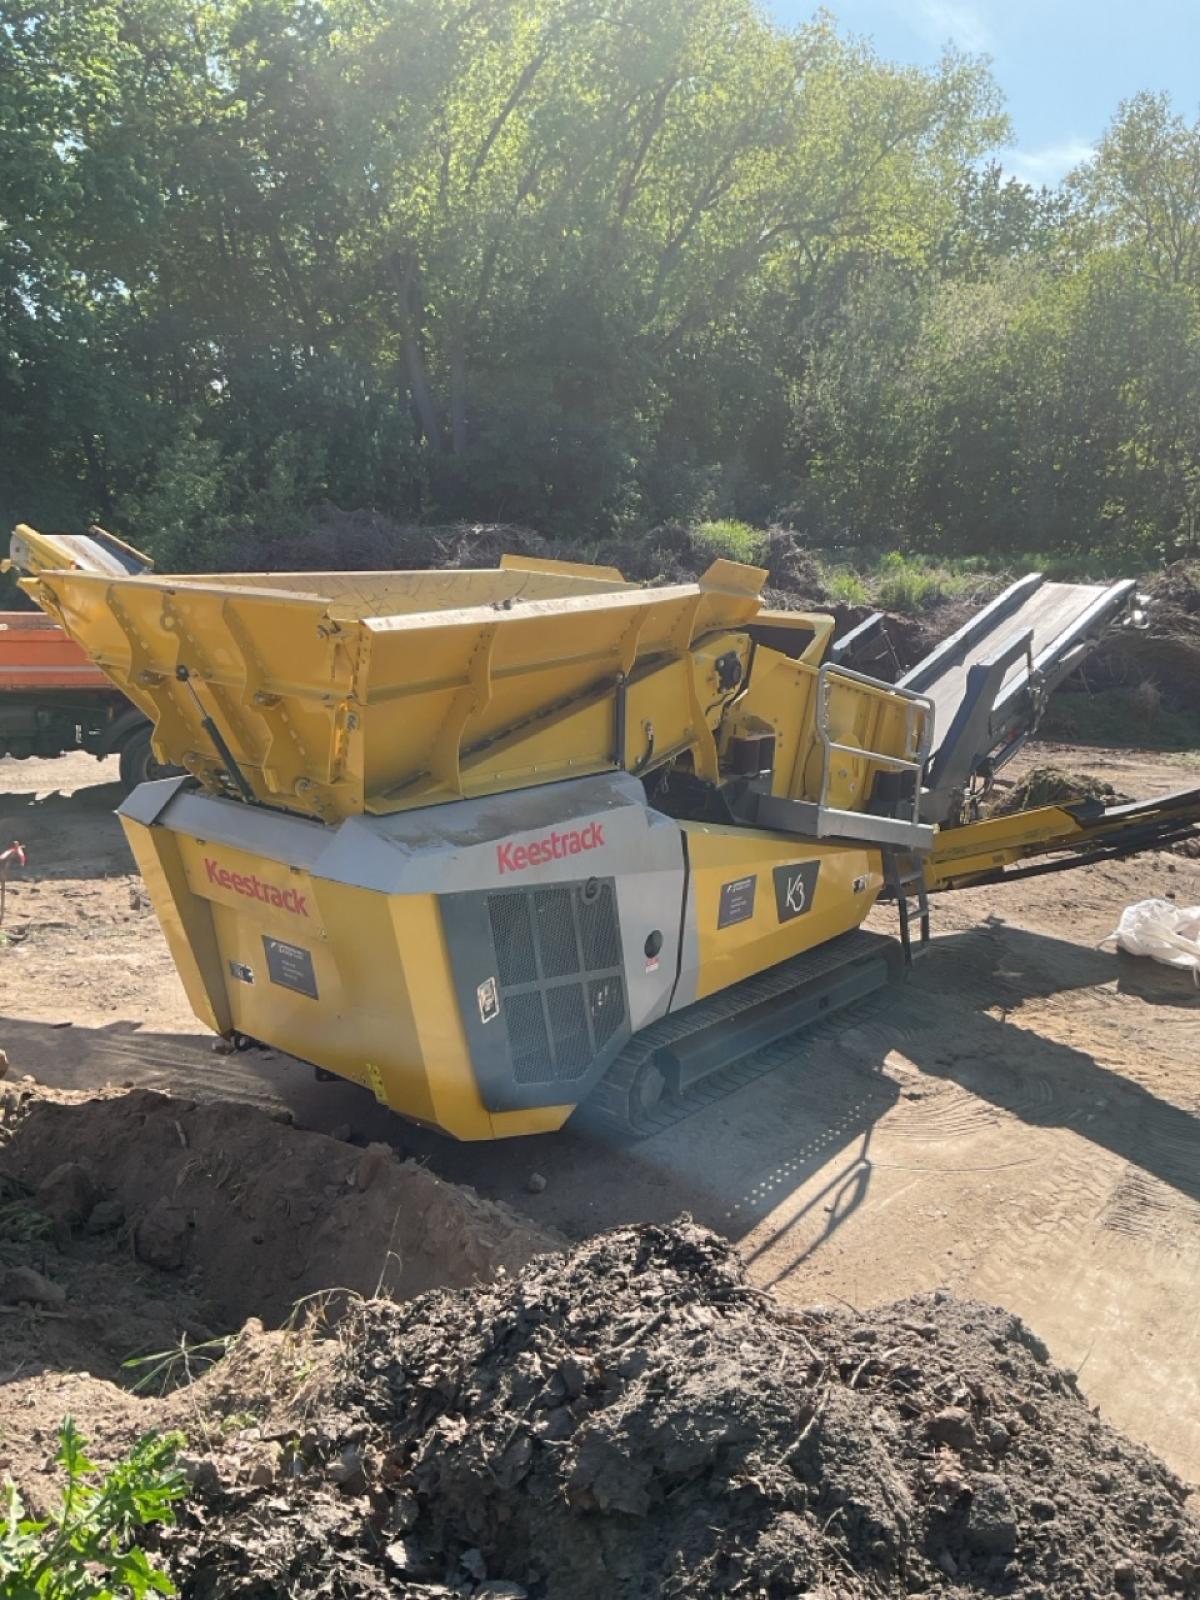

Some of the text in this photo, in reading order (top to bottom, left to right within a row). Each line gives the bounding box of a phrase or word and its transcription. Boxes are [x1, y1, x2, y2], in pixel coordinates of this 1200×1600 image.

[496, 822, 605, 874] Keestrack
[204, 858, 308, 917] Keestrack
[786, 873, 806, 912] K3
